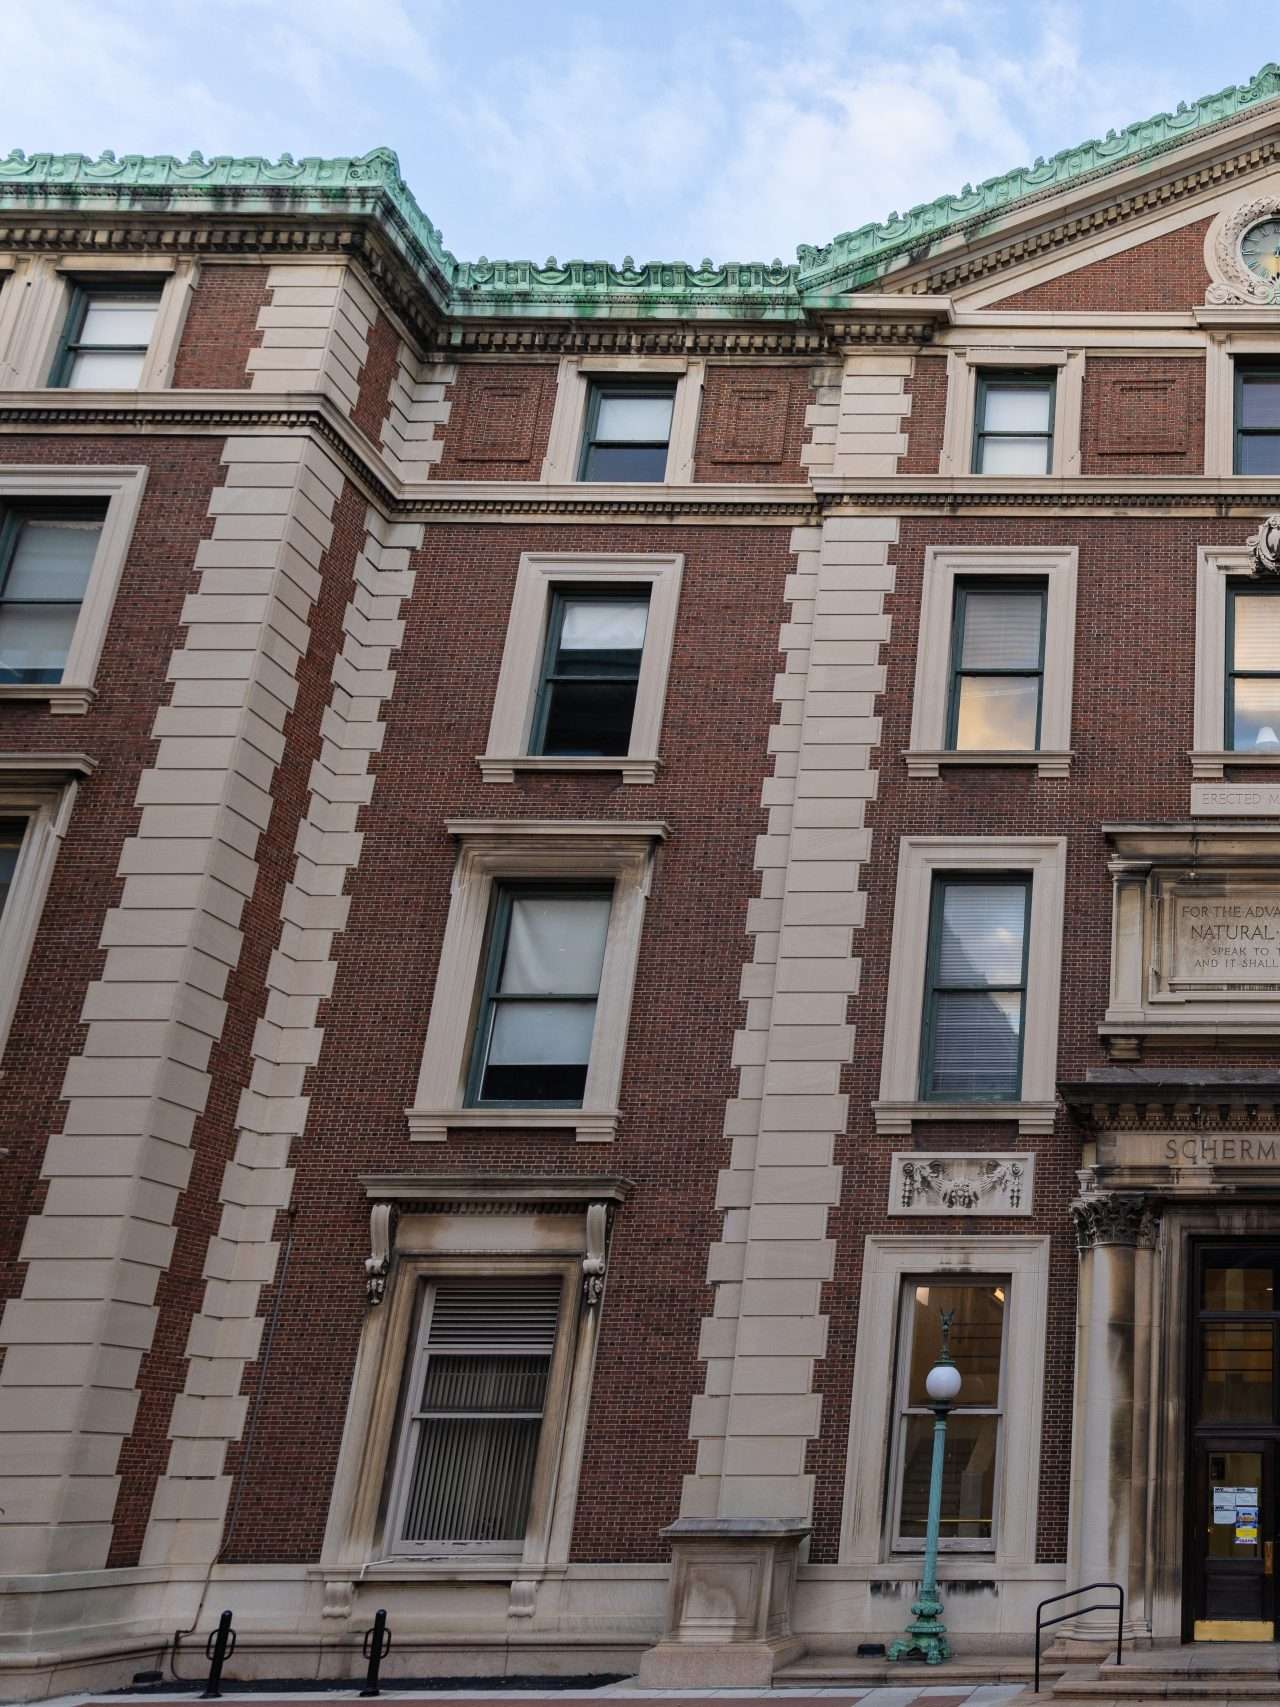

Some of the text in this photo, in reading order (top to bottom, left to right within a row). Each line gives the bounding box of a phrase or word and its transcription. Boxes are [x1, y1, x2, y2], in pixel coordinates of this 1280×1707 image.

[1201, 793, 1262, 805] ERECTED
[1182, 906, 1208, 918] FOR
[1213, 906, 1241, 918] THE
[1191, 925, 1275, 941] NATURAL
[1211, 947, 1247, 957] SPEAK
[1254, 947, 1270, 957] TO
[1194, 959, 1218, 968] AND
[1225, 959, 1236, 968] IT
[1242, 959, 1280, 968] SHALL
